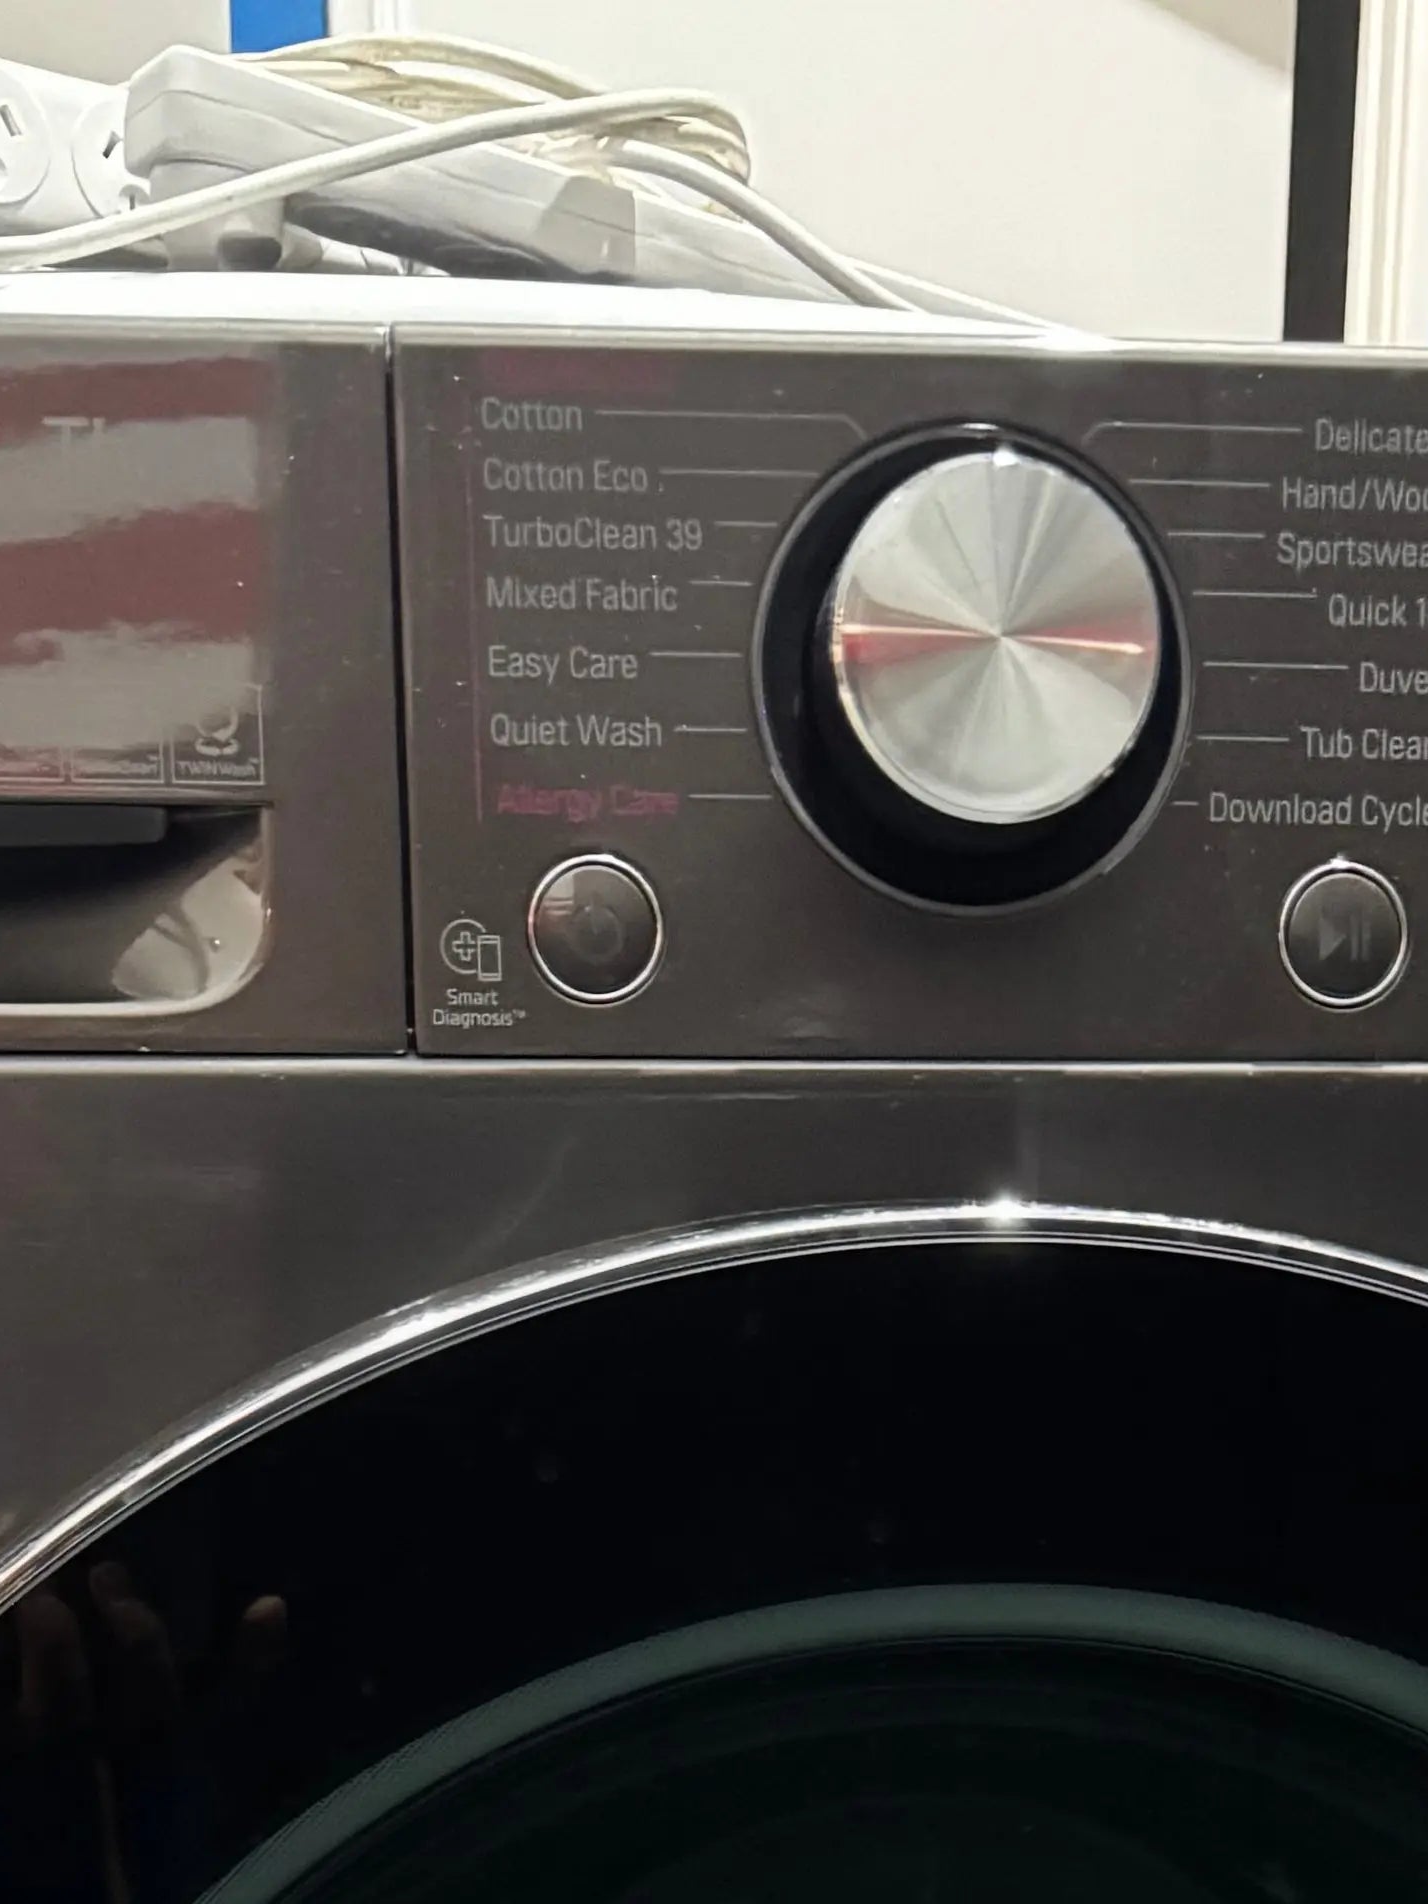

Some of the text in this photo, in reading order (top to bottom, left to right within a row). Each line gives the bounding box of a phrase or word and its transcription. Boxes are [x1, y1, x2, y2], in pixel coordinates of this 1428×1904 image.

[481, 397, 582, 431] Cotton
[483, 458, 648, 493] Cotton Eco
[483, 514, 702, 550] TurboClean 39
[486, 577, 678, 612] Mixed Fabric
[1329, 594, 1406, 628] Quick
[489, 646, 638, 684] Easy Care
[491, 713, 662, 748] Quiet Wash
[1300, 726, 1353, 760] Tub
[1210, 792, 1351, 825] Download
[447, 988, 498, 1006] Smart
